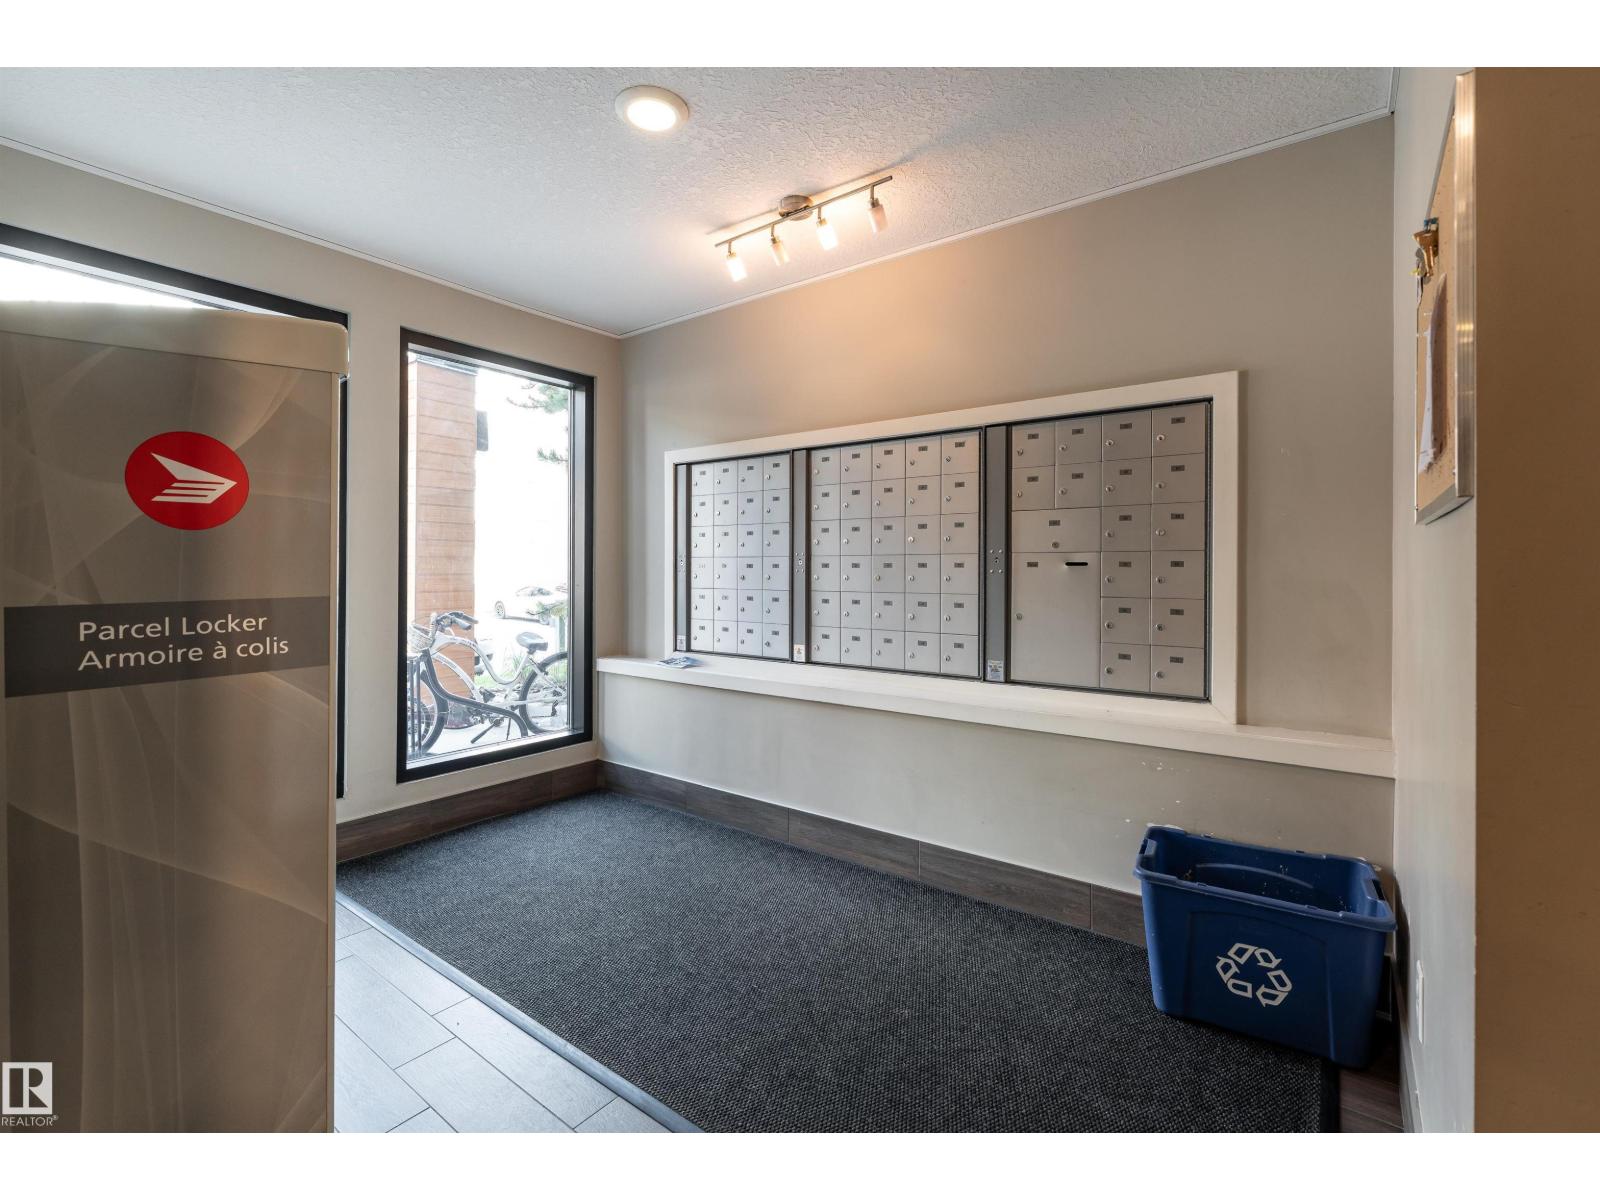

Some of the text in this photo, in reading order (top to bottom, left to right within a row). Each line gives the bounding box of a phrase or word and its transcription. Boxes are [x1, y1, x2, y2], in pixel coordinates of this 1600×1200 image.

[79, 614, 267, 642] Parcel Locker
[77, 637, 289, 671] Armoire à colis
